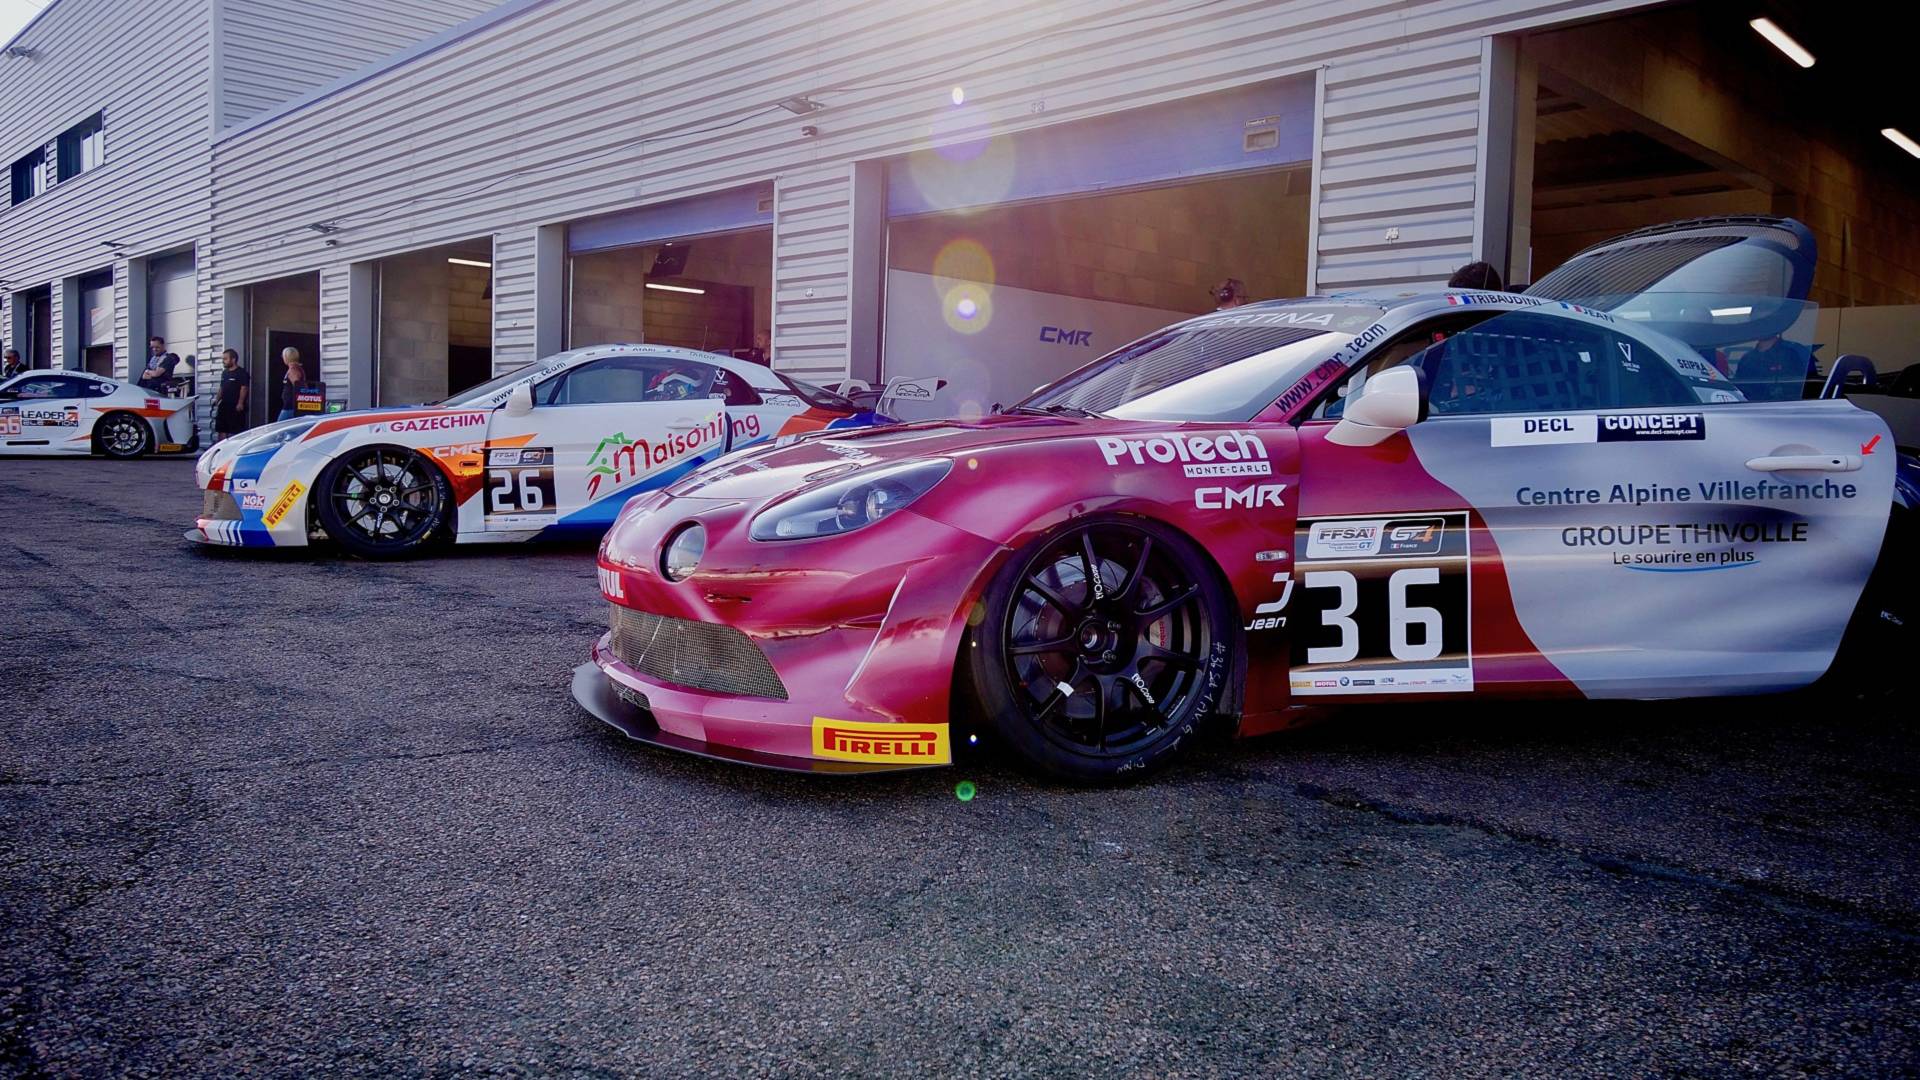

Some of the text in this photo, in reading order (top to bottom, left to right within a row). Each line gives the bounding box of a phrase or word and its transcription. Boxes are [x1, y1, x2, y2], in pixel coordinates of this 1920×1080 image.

[1469, 294, 1542, 306] TRIBAUDINI
[1582, 307, 1615, 323] JEAN
[1040, 326, 1093, 346] CMR
[1275, 322, 1387, 414] www.cmr.team
[21, 410, 65, 420] LEADER
[390, 414, 485, 432] GAZECHIM
[1524, 414, 1699, 433] DECL CONCEPT
[1095, 429, 1268, 466] ProTech
[1186, 464, 1268, 475] MONTE-CARLO
[490, 469, 543, 512] 26
[1194, 484, 1287, 510] CMR
[1516, 479, 1857, 506] Centre Alpine Villefranche
[242, 495, 265, 506] NGK
[265, 482, 301, 526] PIRELLI
[1390, 525, 1435, 542] GT4
[1561, 522, 1809, 547] GROUPE THIVOLLE
[1613, 548, 1755, 566] Le sourire en plus
[1244, 616, 1287, 631] Jean
[1305, 567, 1443, 664] 36
[824, 727, 937, 755] PIRELLI
